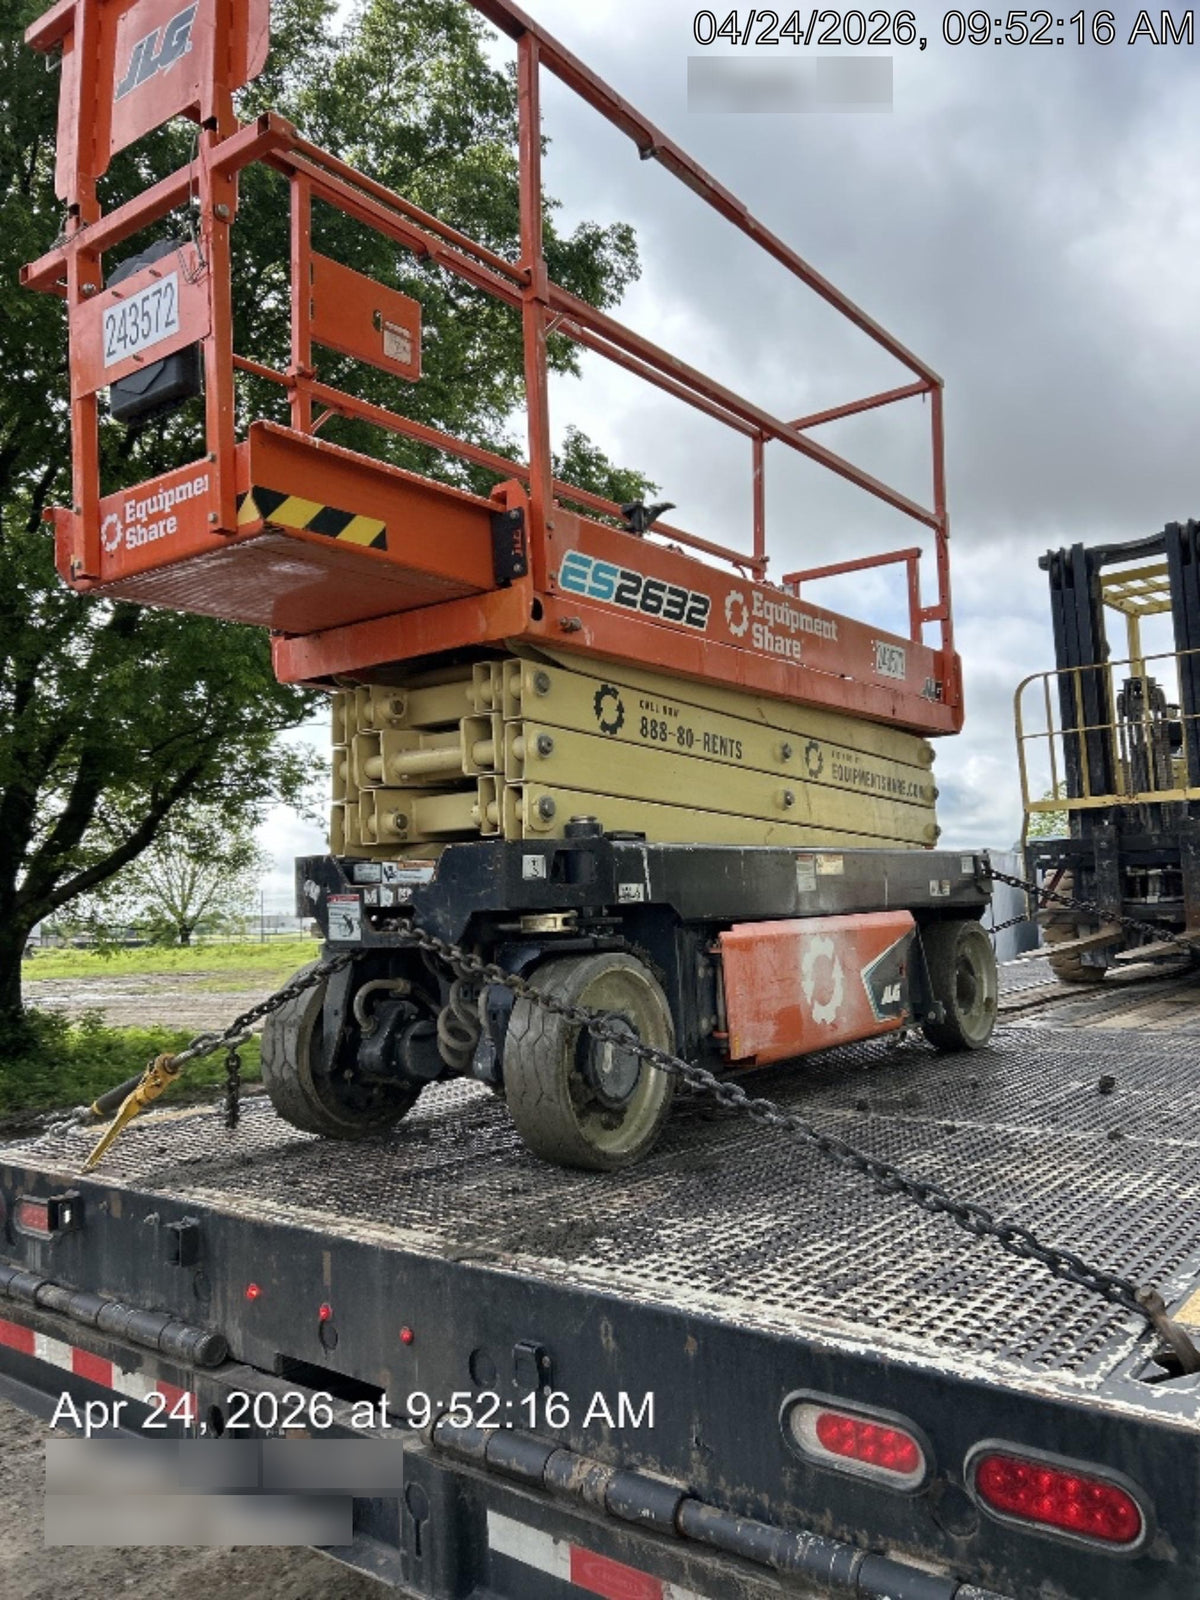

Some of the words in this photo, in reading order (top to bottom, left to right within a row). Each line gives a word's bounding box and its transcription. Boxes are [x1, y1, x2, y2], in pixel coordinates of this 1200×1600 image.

[114, 1, 199, 103] JLG
[105, 282, 176, 358] 243572
[125, 516, 177, 550] Share
[558, 549, 712, 632] ES2632
[751, 590, 839, 643] Equipment
[751, 622, 802, 659] Share
[639, 715, 743, 761] 888-80-RENTS
